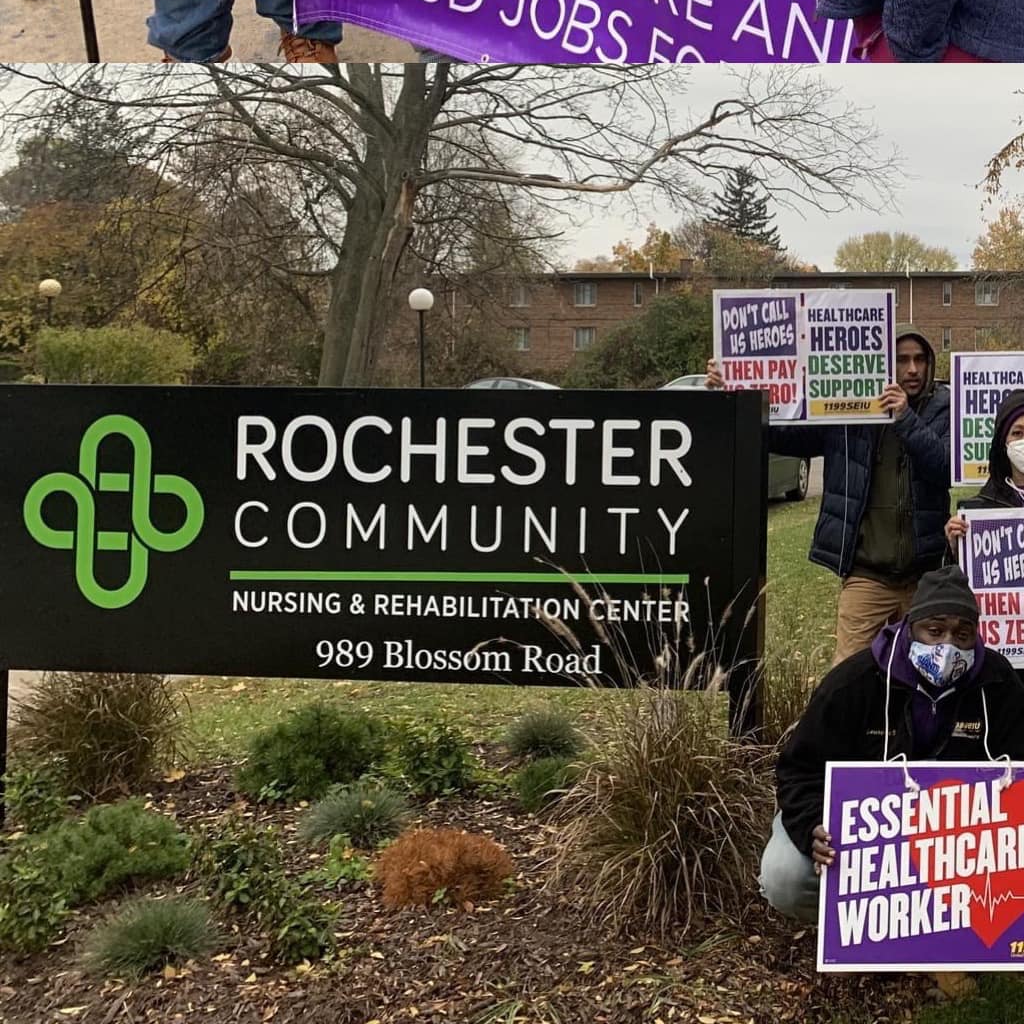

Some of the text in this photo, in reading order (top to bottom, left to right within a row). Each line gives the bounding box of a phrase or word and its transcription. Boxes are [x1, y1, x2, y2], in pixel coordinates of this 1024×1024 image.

[722, 299, 789, 331] DON'T CALL
[807, 307, 885, 323] HEALTHCARE
[729, 323, 794, 355] US HEROES
[810, 326, 883, 352] HEROES
[722, 359, 798, 381] THEN PAY
[808, 354, 886, 375] DESERVE
[809, 378, 886, 399] SUPPORT
[823, 401, 871, 411] 1199SEIU
[235, 414, 693, 487] ROCHESTER
[234, 501, 690, 556] COMMUNITY
[973, 526, 1012, 558] DON'T
[982, 560, 1000, 586] US
[232, 590, 690, 623] NURSING & REHABILITATION CENTER
[976, 591, 1020, 616] THEN
[316, 639, 603, 675] 989 Blossom Road
[840, 779, 1008, 845] ESSENTIAL
[837, 883, 972, 947] WORKER
